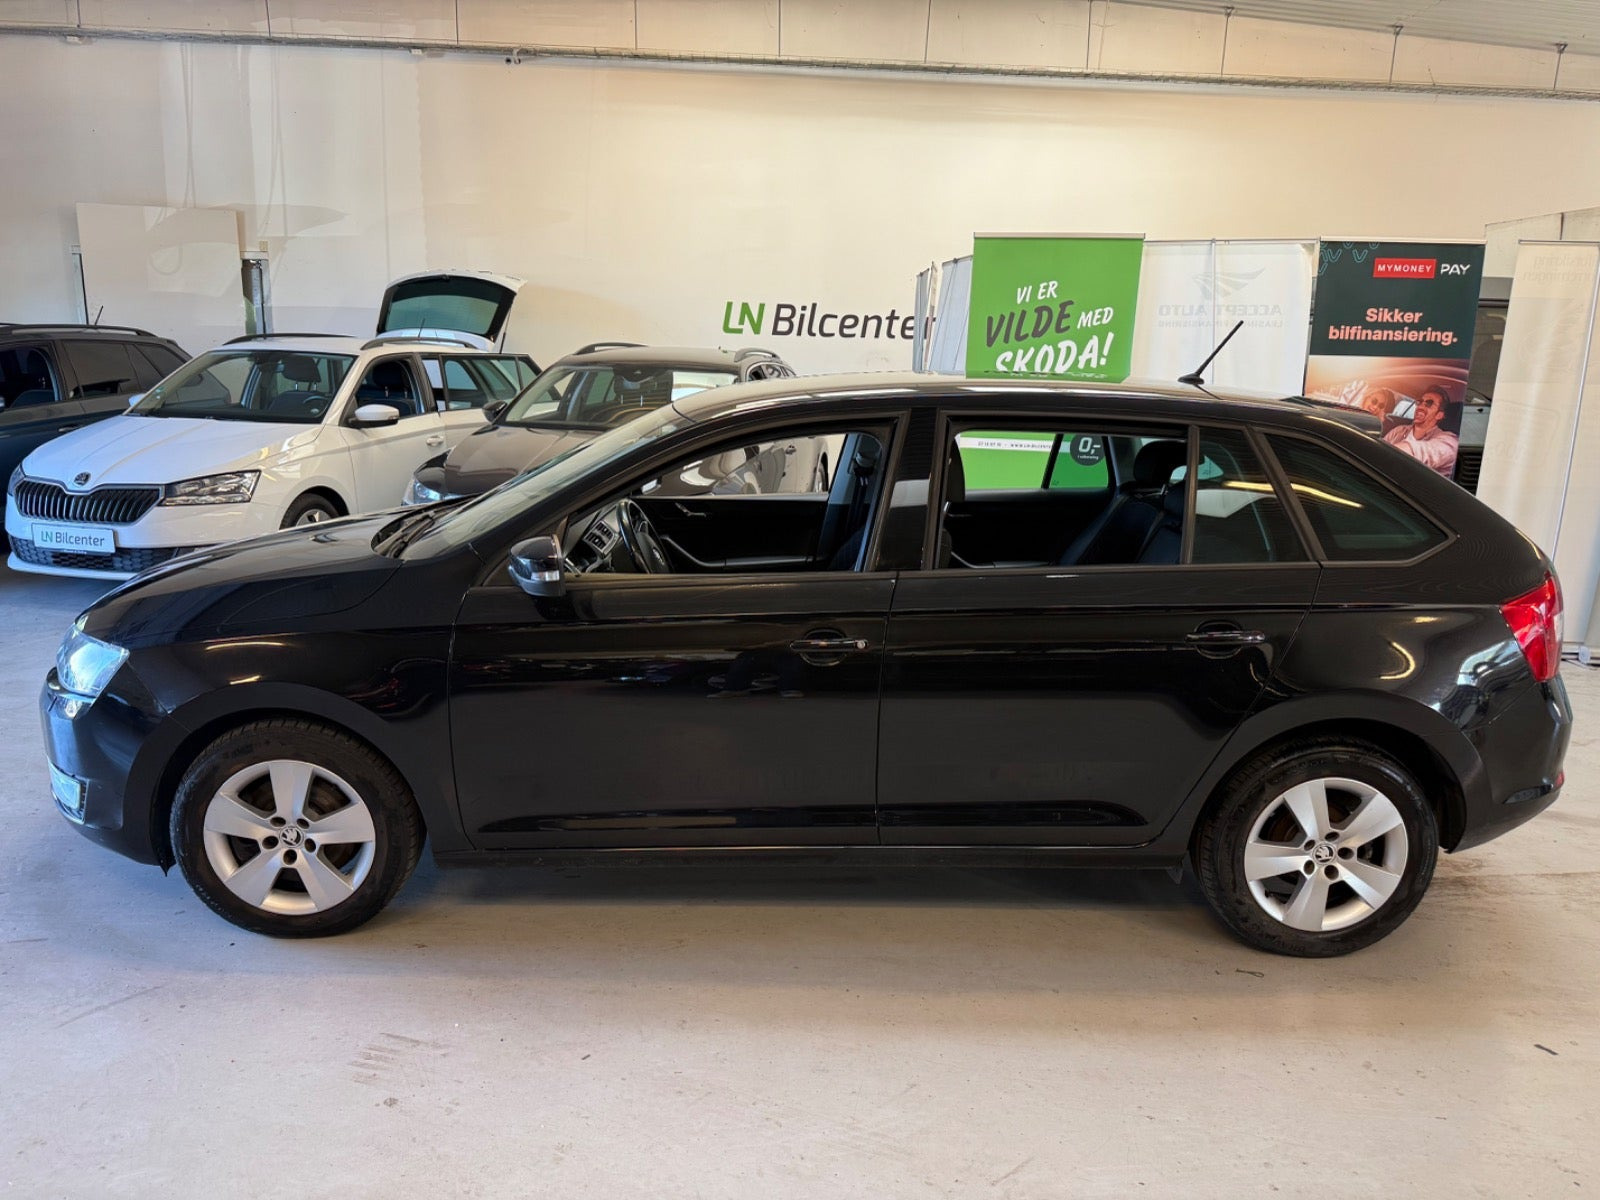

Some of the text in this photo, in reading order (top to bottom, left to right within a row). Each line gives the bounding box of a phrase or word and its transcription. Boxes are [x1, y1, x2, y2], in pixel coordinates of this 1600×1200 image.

[1377, 264, 1471, 275] MYMONEY PAY
[1016, 280, 1058, 304] VI ER
[722, 301, 766, 335] LN
[986, 300, 1114, 348] VILDE MED
[1365, 307, 1423, 323] Sikker
[1328, 325, 1458, 346] bilfinansiering.
[995, 331, 1114, 374] SKODA!
[55, 531, 105, 547] Bilcenter
